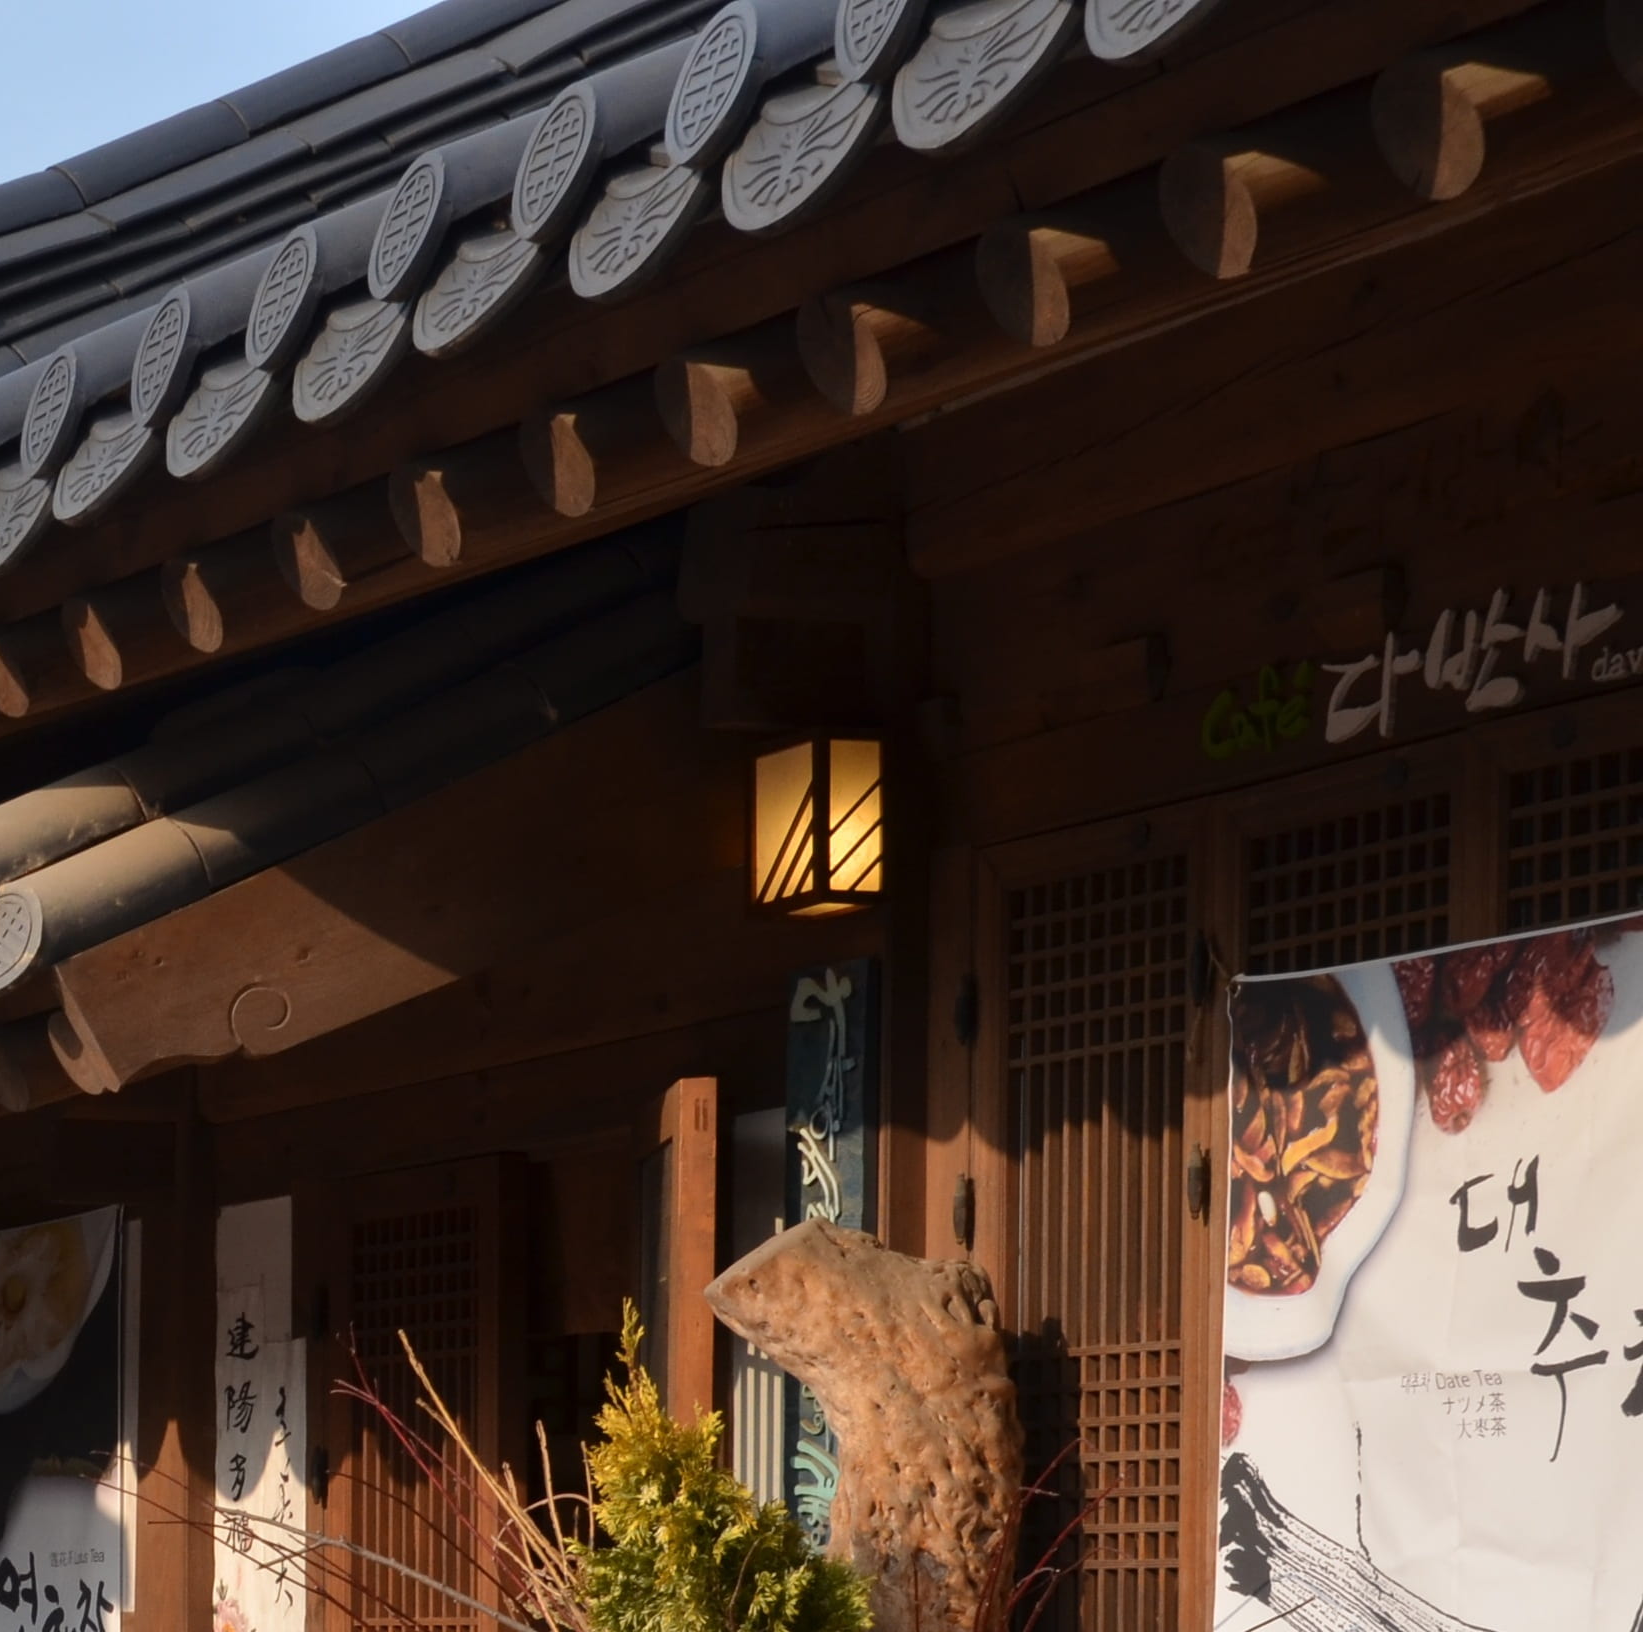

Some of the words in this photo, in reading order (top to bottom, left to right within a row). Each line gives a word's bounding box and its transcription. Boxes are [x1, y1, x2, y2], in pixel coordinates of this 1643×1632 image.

[1435, 1372, 1470, 1390] Date
[1473, 1369, 1502, 1386] Tea
[1442, 1393, 1506, 1415] ナツメ茶
